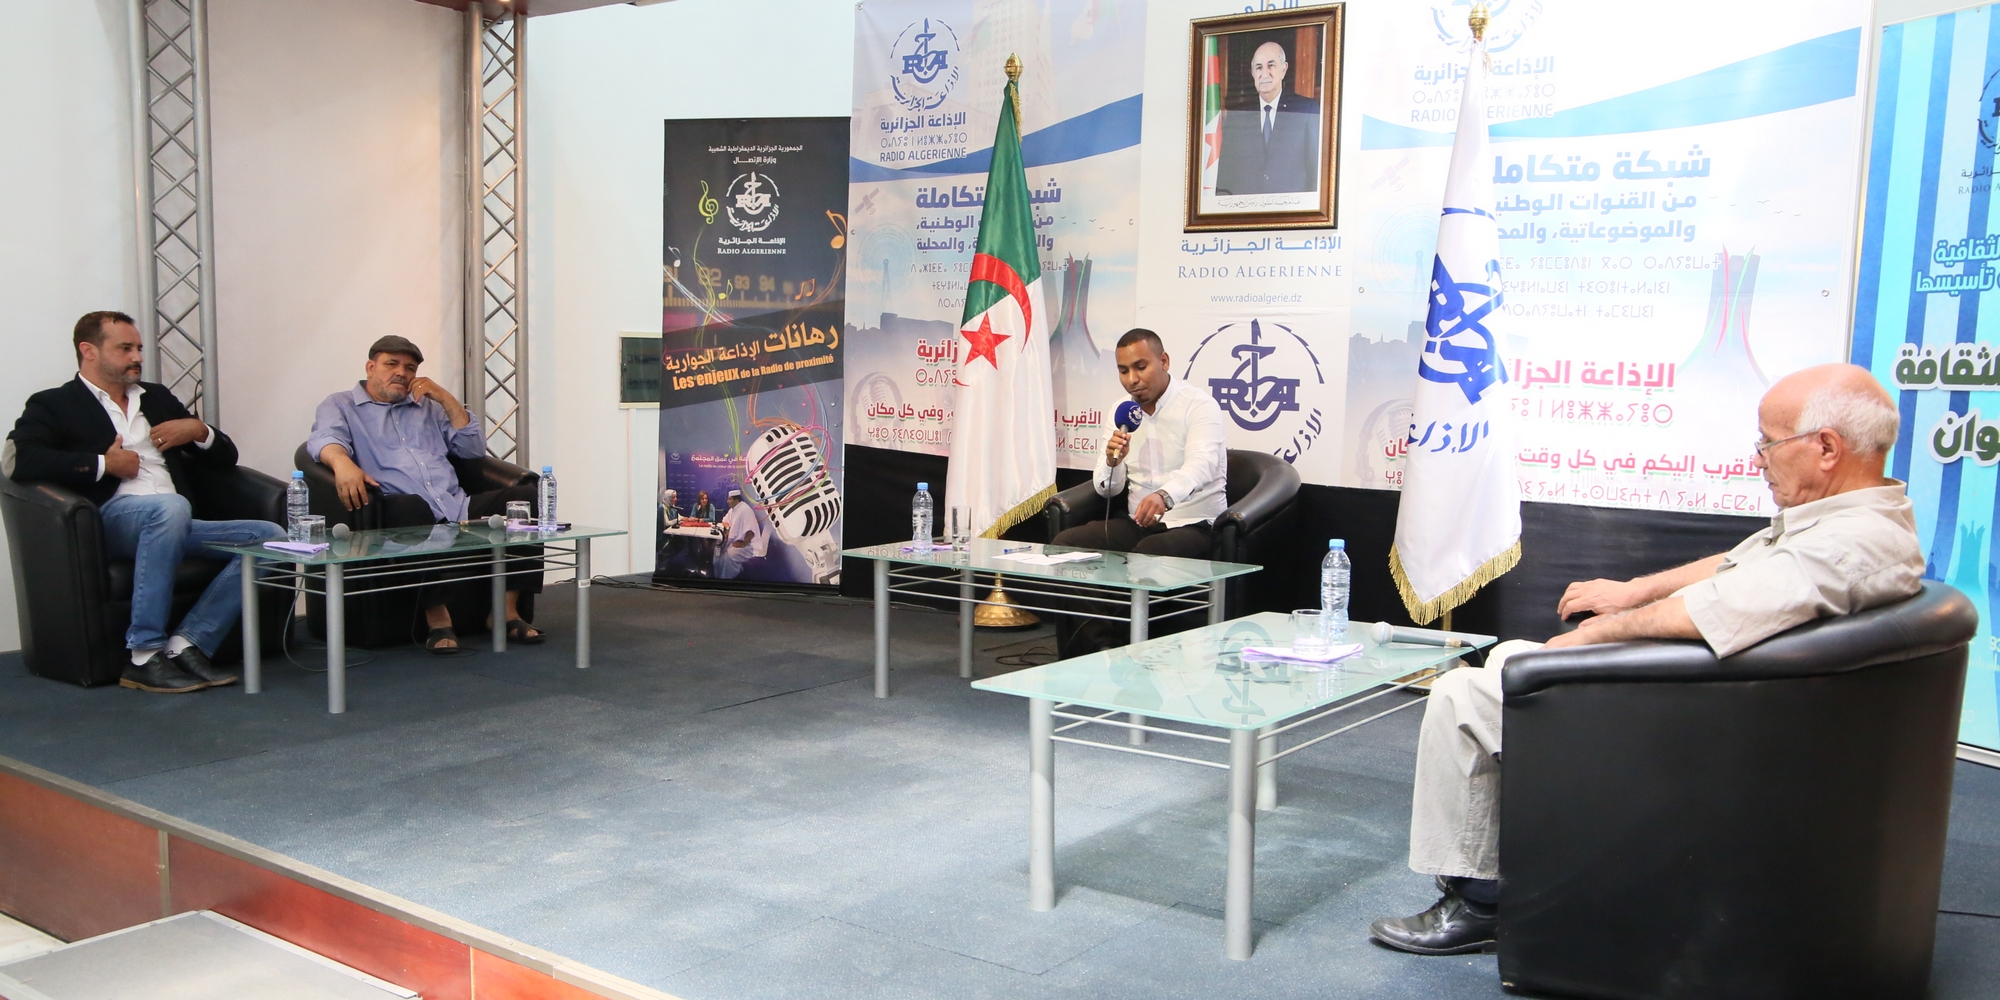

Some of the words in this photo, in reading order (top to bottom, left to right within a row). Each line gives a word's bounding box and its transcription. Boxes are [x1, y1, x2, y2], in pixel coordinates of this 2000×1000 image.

[1414, 62, 1468, 85] جزائرية
[1491, 56, 1555, 79] الإذاعة
[928, 111, 966, 130] الإذاعة
[1411, 108, 1456, 122] RADIO
[1487, 103, 1553, 118] ERIENNE
[880, 115, 925, 133] الجزائرية
[880, 150, 905, 162] RADIO
[908, 147, 967, 161] ALGERIENNE
[1493, 153, 1600, 184] متكامل
[1613, 144, 1711, 188] شبكة
[1961, 165, 2000, 178] زائرية
[916, 185, 985, 209] تكاملة
[1958, 183, 1991, 195] RADIO
[1495, 193, 1563, 217] الوطني
[1569, 191, 1655, 215] القنوات
[1662, 193, 1697, 212] من
[718, 236, 757, 246] الجزائرية
[758, 236, 786, 246] الإذاعة
[1552, 219, 1696, 243] والموضوعاتية،
[717, 247, 740, 255] RADIO
[742, 247, 787, 255] ALGERIENNE
[916, 237, 965, 254] والمحلية
[1181, 237, 1271, 256] الجزائرية
[1274, 236, 1342, 253] الإذاعة
[1935, 236, 2000, 267] لثقافية
[1178, 266, 1229, 279] RADIO
[1236, 265, 1343, 279] ALGERIENNE
[1915, 266, 1995, 295] تأسيسها
[1210, 293, 1302, 305] www.radioalgerie.dz
[763, 322, 839, 353] رهانات
[665, 349, 714, 374] الجوارية
[718, 340, 760, 361] الإذاعة
[917, 339, 959, 364] زائرية
[673, 375, 695, 391] Les
[697, 368, 741, 387] enjeux
[741, 369, 750, 379] de
[751, 367, 760, 377] la
[761, 364, 783, 376] Radio
[784, 361, 794, 371] de
[795, 353, 834, 370] proximité
[1894, 346, 2000, 386] لثقافة
[1581, 363, 1675, 396] الإذاعة
[867, 402, 895, 417] مكان
[898, 403, 915, 418] كل
[917, 405, 943, 421] وفي
[1061, 408, 1101, 427] الأقرب
[1274, 408, 1323, 465] الإذاع
[1932, 413, 2000, 462] وان
[1568, 449, 1596, 469] كل
[1603, 452, 1636, 475] في
[1642, 454, 1696, 479] إليكم
[1703, 455, 1761, 480] لأقرب
